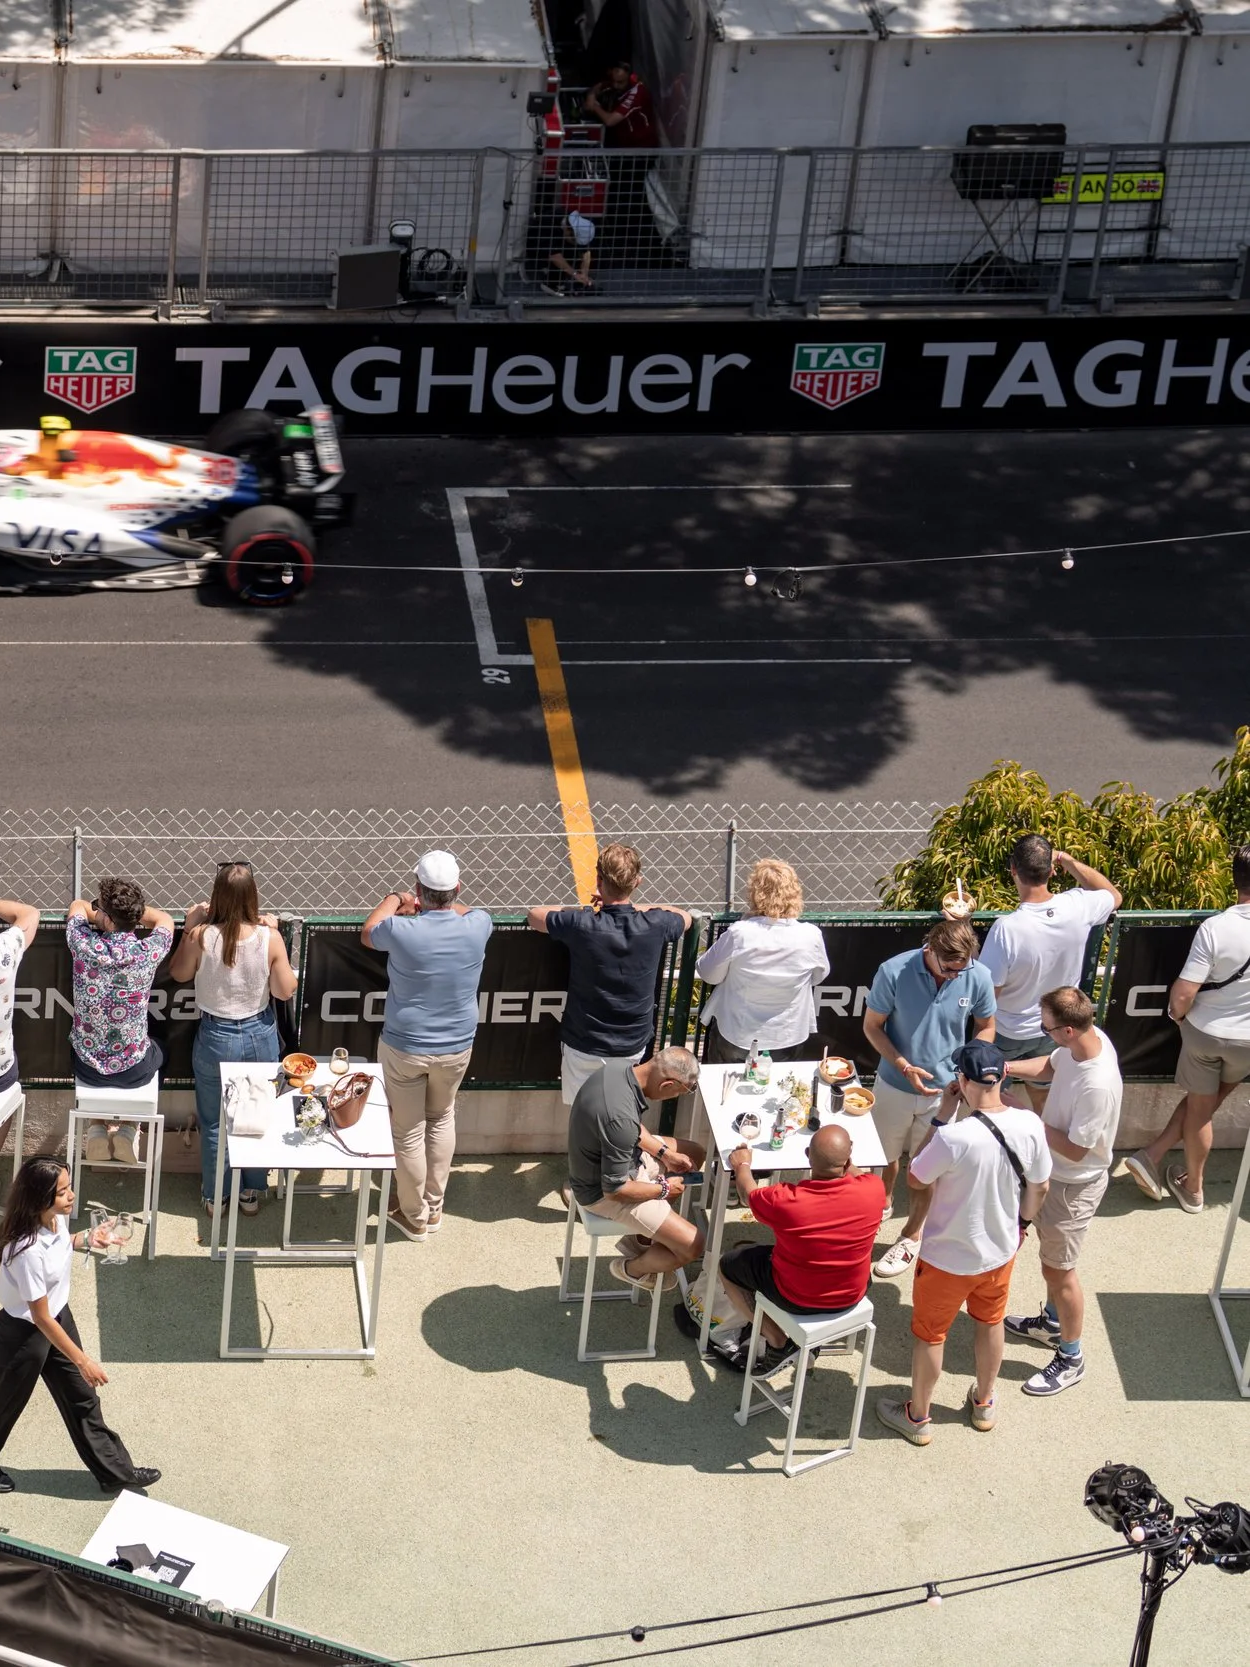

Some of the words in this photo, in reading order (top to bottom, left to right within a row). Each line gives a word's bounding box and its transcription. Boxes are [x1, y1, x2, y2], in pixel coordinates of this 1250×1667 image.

[1071, 180, 1135, 195] ANDO
[53, 351, 128, 371] TAG
[802, 347, 876, 368] TAG
[49, 377, 130, 408] HEUER
[796, 373, 876, 404] HEUER
[5, 521, 101, 554] VISA
[481, 667, 511, 684] 29
